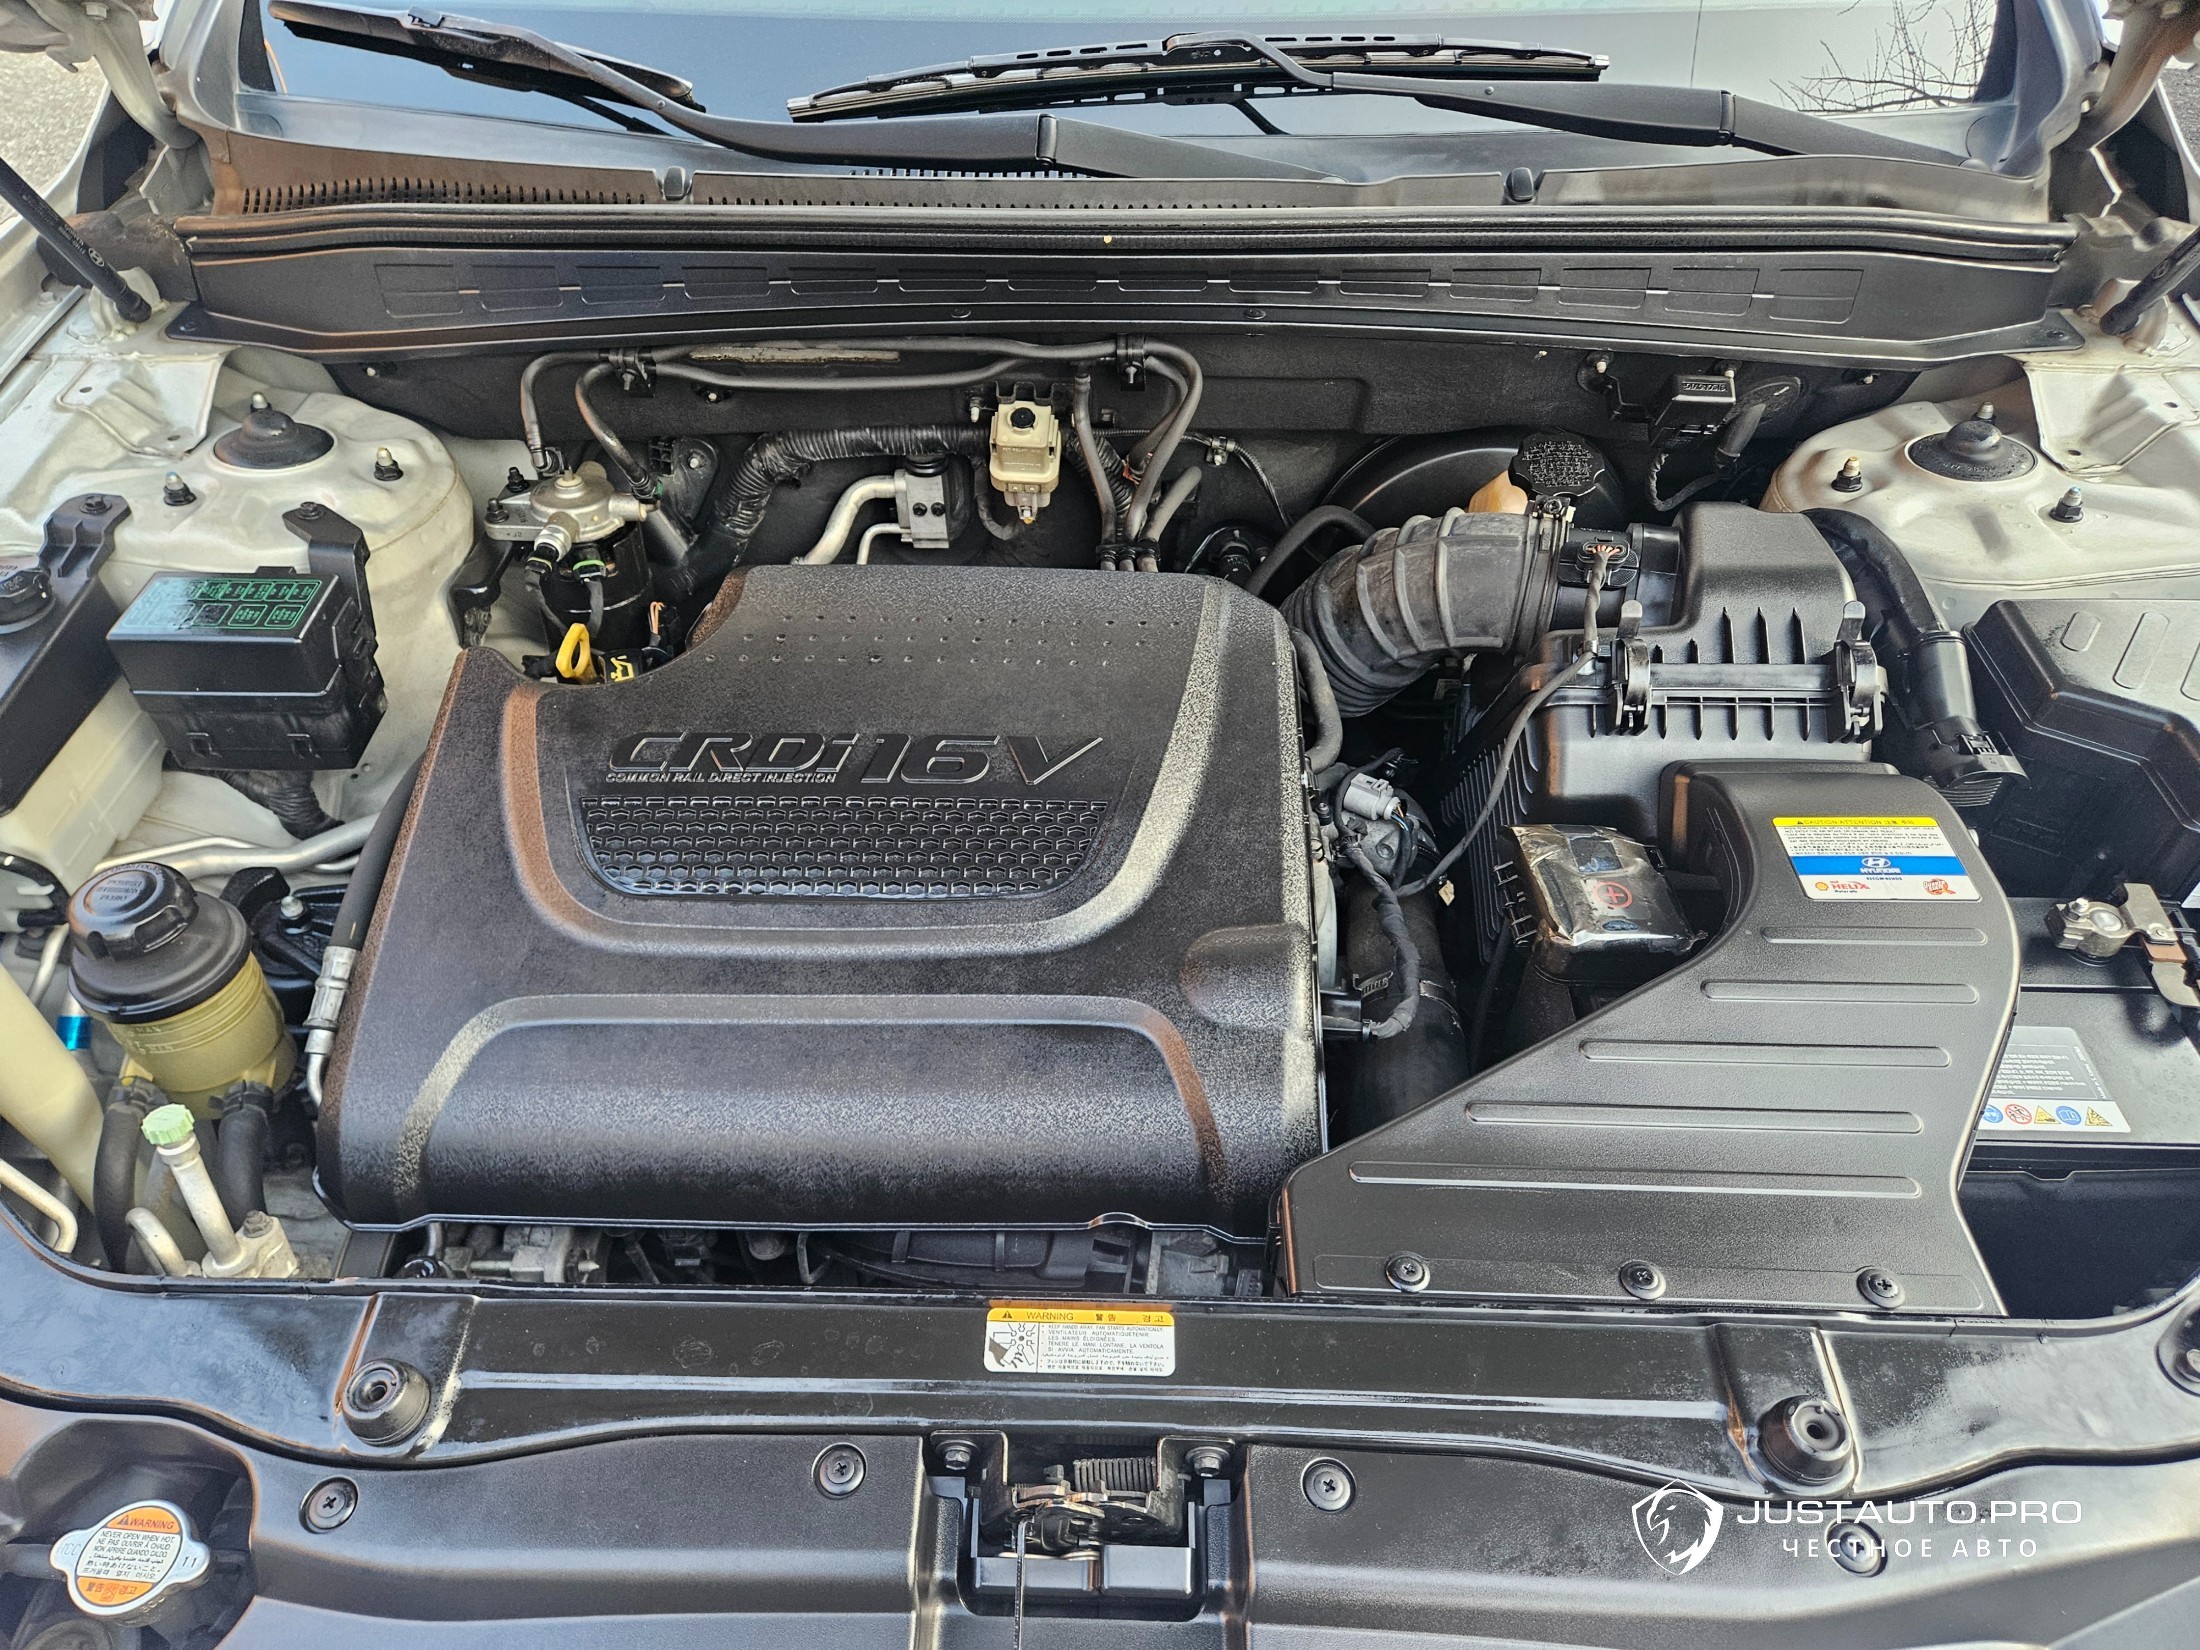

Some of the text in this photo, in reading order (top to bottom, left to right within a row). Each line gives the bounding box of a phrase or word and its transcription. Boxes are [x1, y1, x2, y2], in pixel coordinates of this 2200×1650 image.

[605, 772, 837, 783] COMMON RAIL DIRECT INJECTION
[1026, 1311, 1074, 1321] WARNING
[130, 1518, 175, 1530] WARNING
[100, 1530, 122, 1538] NEVER
[122, 1531, 140, 1540] OPEN
[141, 1533, 159, 1541] WHEN
[107, 1538, 119, 1546] PAS
[121, 1539, 143, 1547] OUVRIR
[106, 1546, 126, 1554] APRIRE
[127, 1548, 149, 1556] QUANDO
[119, 1584, 138, 1595] 경고
